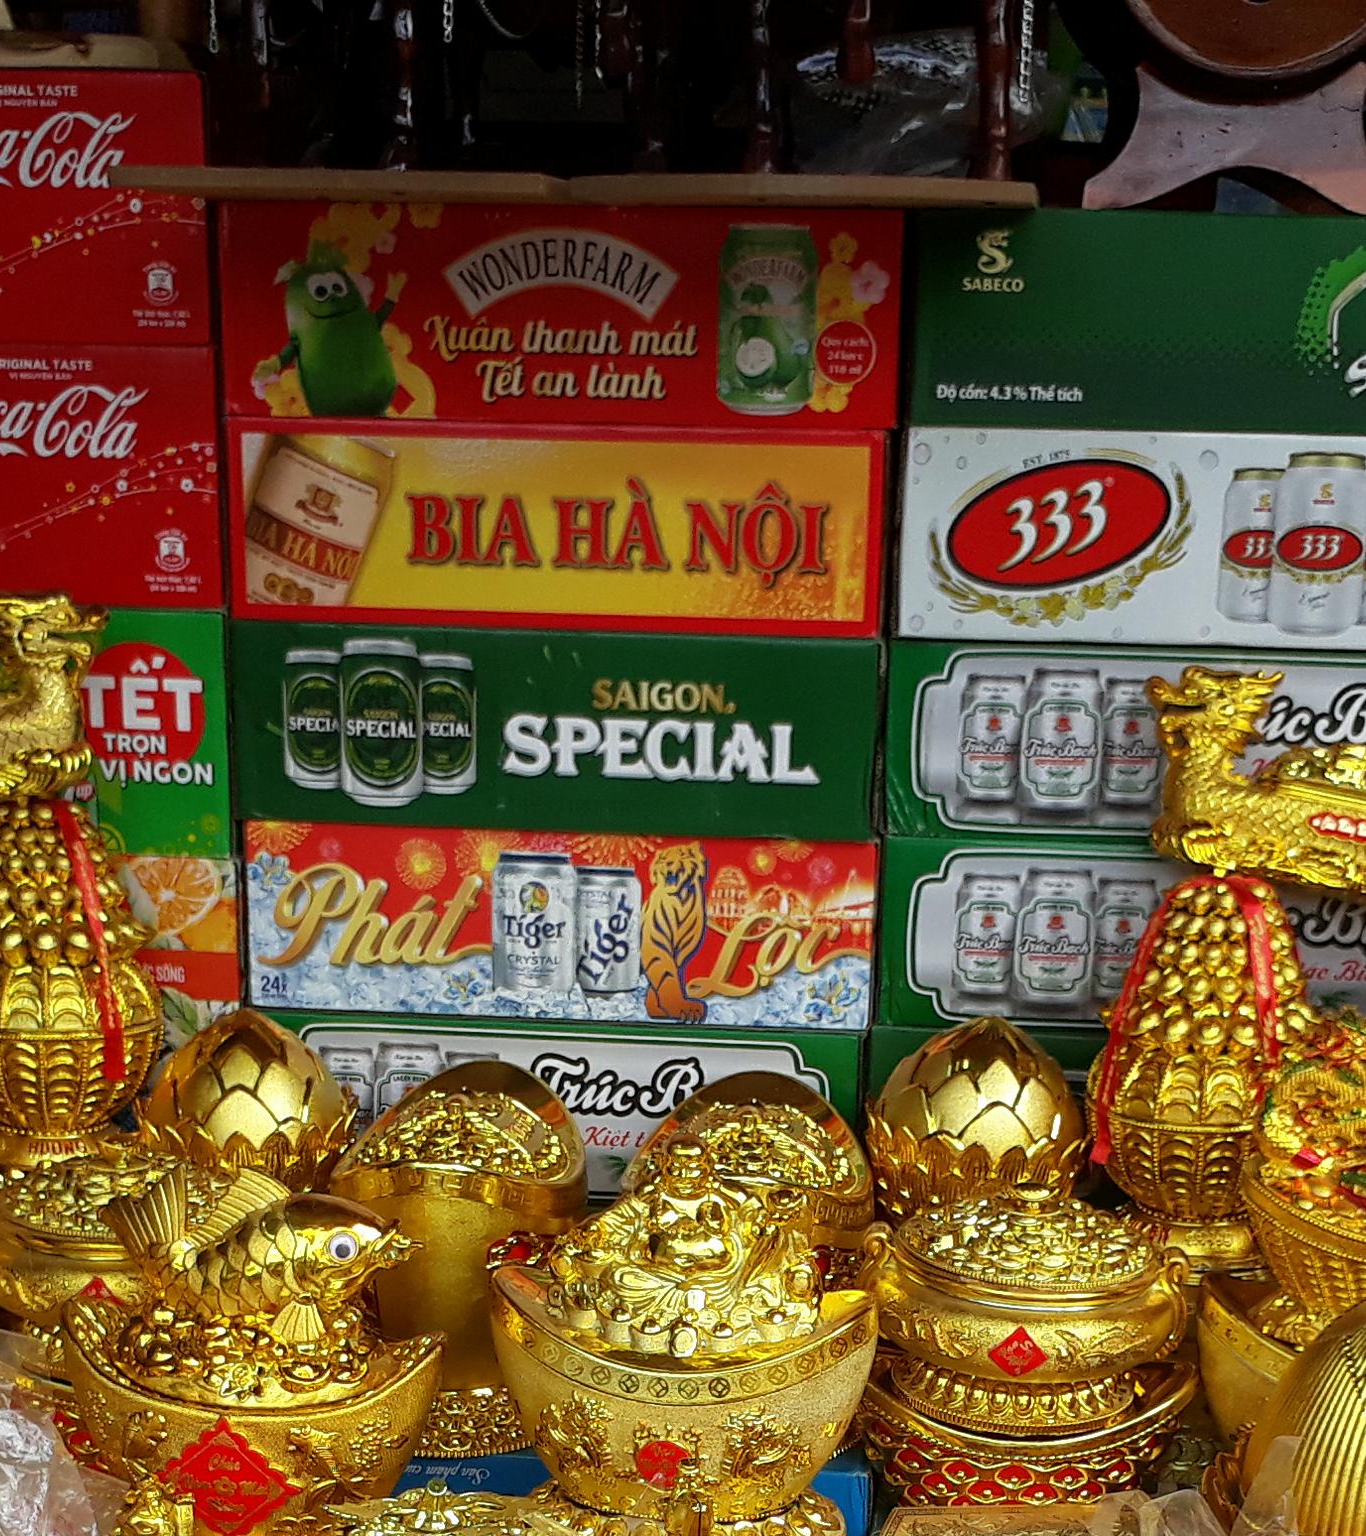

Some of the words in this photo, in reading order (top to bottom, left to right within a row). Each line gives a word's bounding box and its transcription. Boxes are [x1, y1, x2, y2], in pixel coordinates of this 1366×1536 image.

[37, 84, 78, 98] TASTE
[458, 234, 663, 304] WONDERFARM
[962, 277, 1024, 293] SABECO
[423, 316, 513, 361] Xuân
[522, 321, 620, 357] thanh
[628, 320, 698, 357] mát
[53, 358, 94, 371] TASTE
[476, 359, 525, 402] Tết
[532, 371, 579, 398] an
[585, 359, 667, 401] lành
[937, 383, 959, 402] Độ
[960, 383, 988, 401] cồn:
[1029, 384, 1055, 402] Thể
[1057, 385, 1083, 402] tích
[406, 492, 541, 569] BIA
[552, 475, 670, 573] HÀ
[685, 482, 828, 589] NỘI
[998, 480, 1110, 571] 333
[1293, 534, 1342, 561] 333
[80, 656, 203, 730] TẾT
[592, 677, 729, 714] SAIGON
[103, 731, 168, 757] TRỌN
[346, 719, 417, 739] SPECIAL
[501, 713, 821, 787] SPECIAL
[101, 757, 129, 789] VỊ
[132, 760, 214, 785] NGON
[255, 862, 495, 968] Phát
[503, 914, 566, 949] Tiger
[576, 894, 634, 985] Tiger
[688, 906, 871, 1001] Lộc
[507, 953, 560, 966] CRYSTAL
[537, 1056, 636, 1114] Trúc
[585, 1126, 632, 1148] Kiệt
